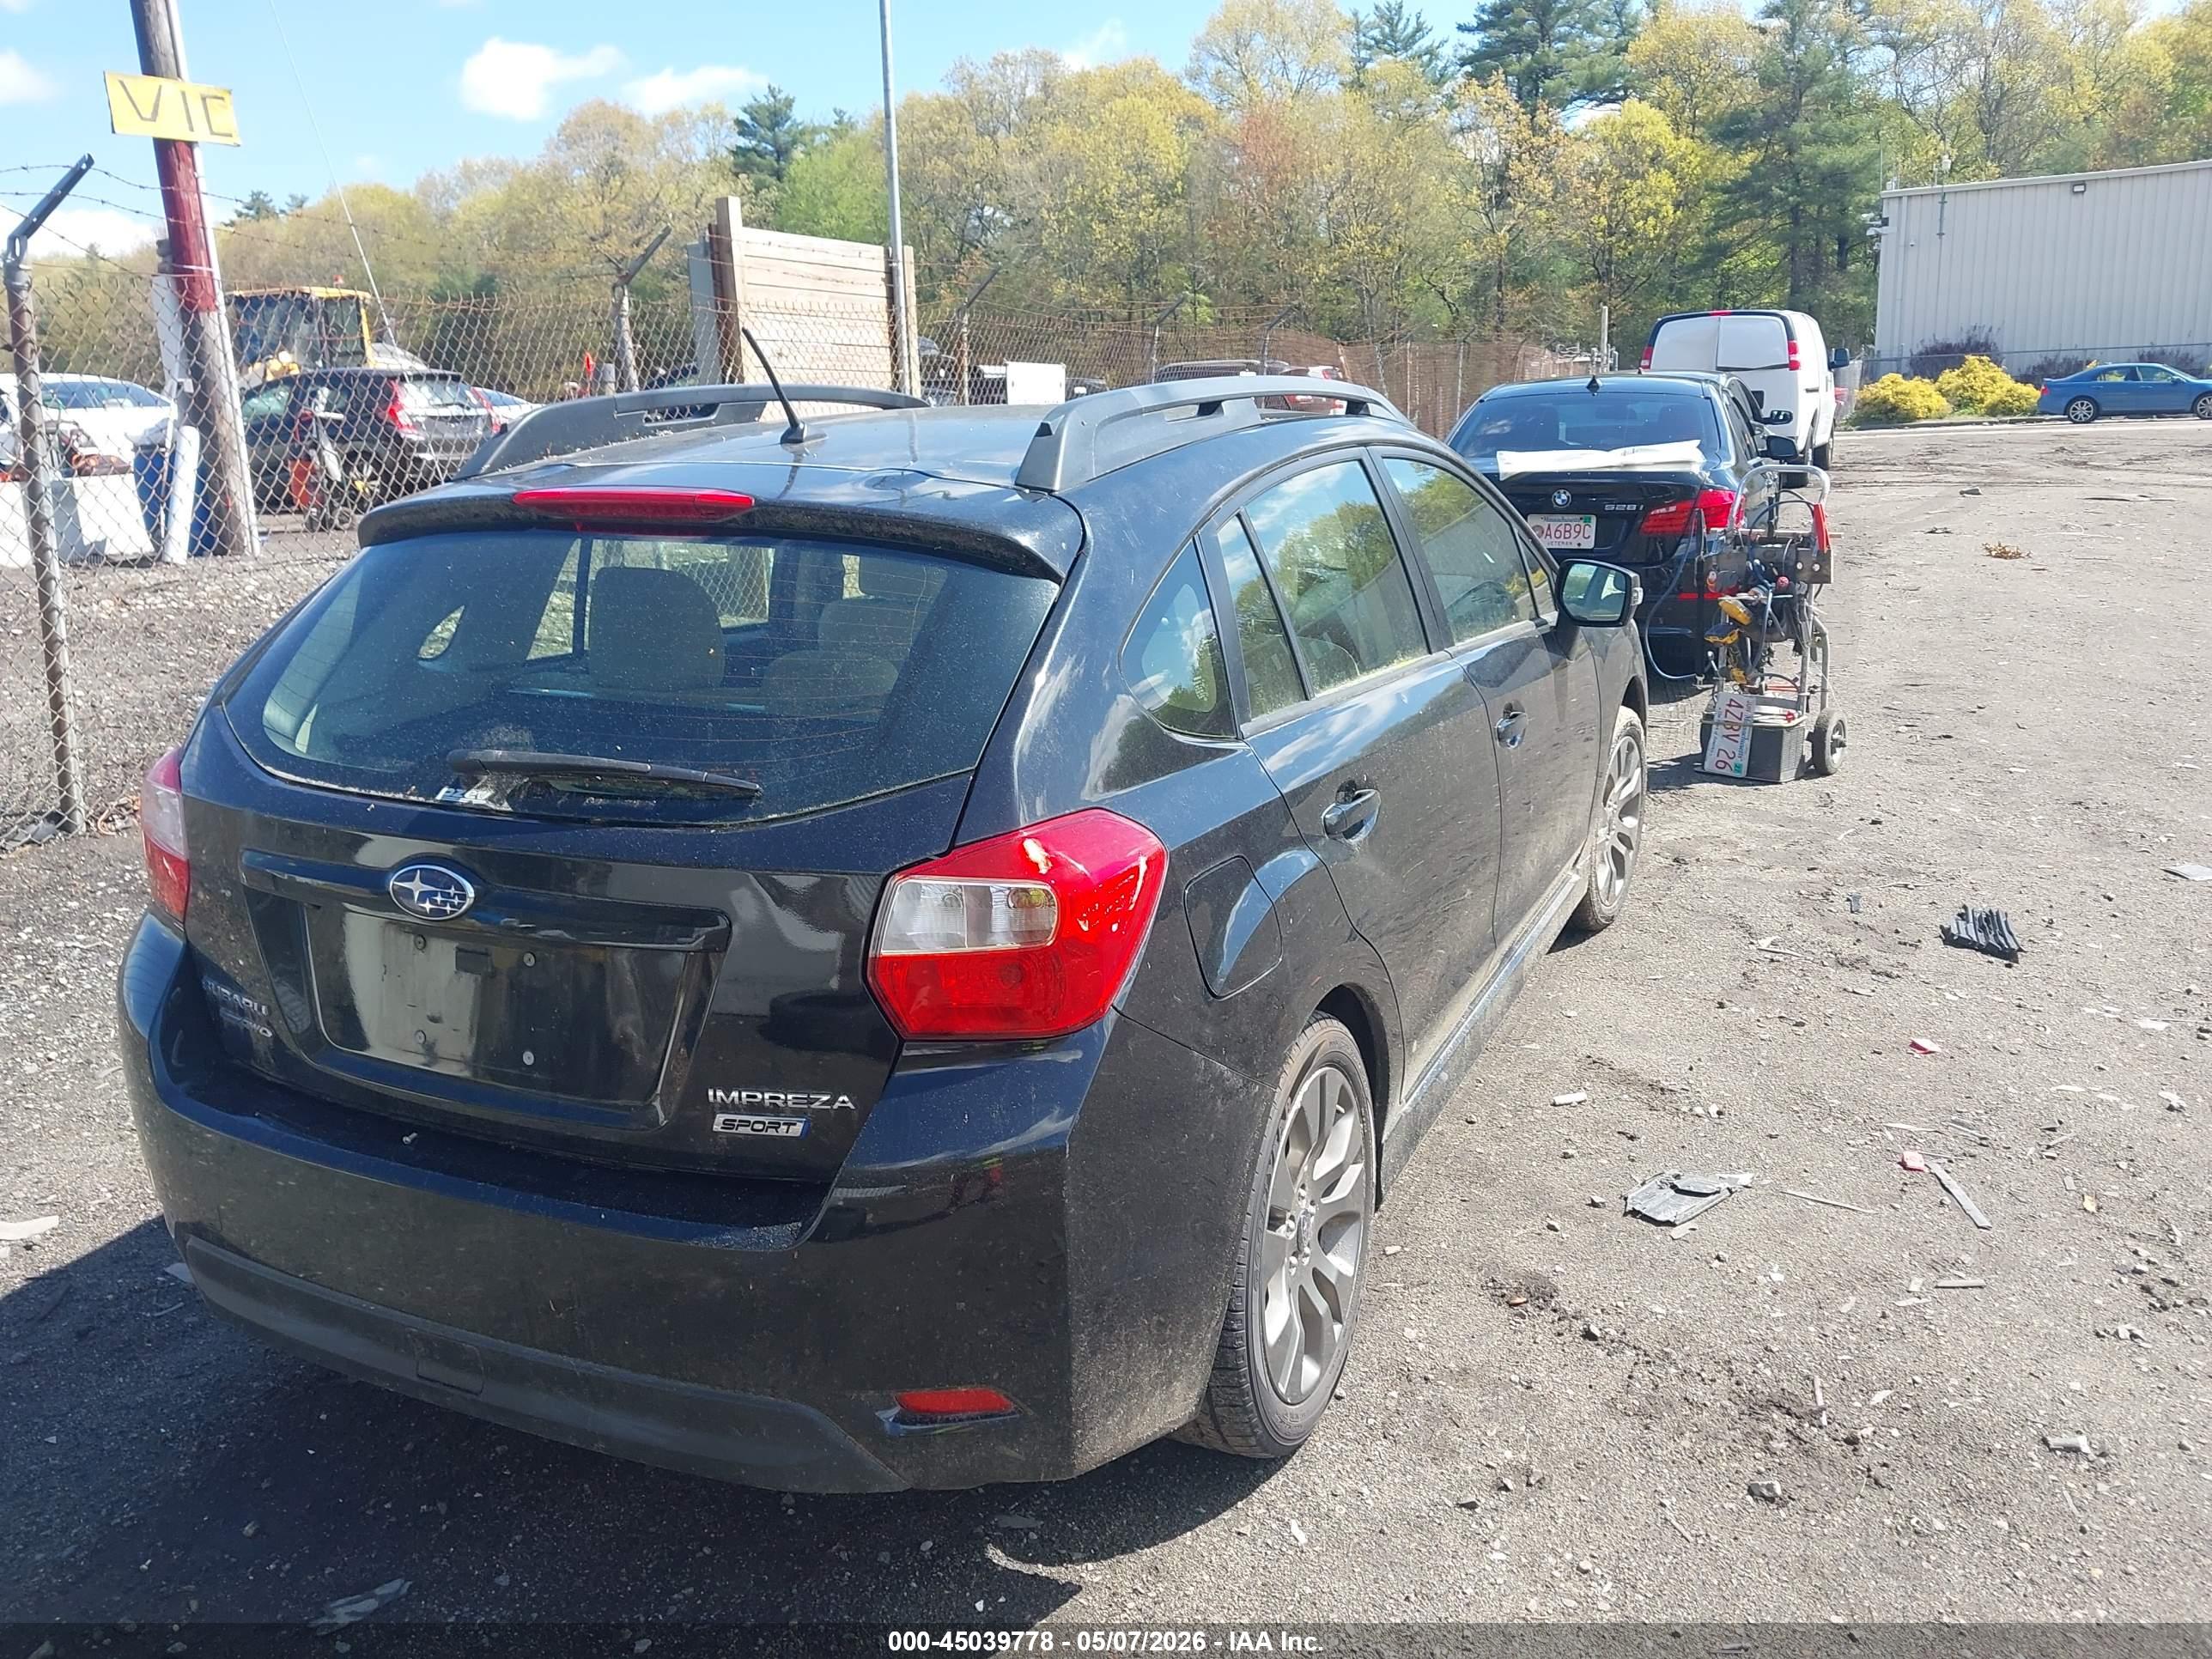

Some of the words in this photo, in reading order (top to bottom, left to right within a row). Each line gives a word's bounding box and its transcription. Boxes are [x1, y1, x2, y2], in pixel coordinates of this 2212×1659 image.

[118, 79, 234, 137] VIC
[1544, 523, 1592, 540] A6B9C
[707, 1088, 856, 1110] IMPREZA
[720, 1118, 798, 1134] SPORT
